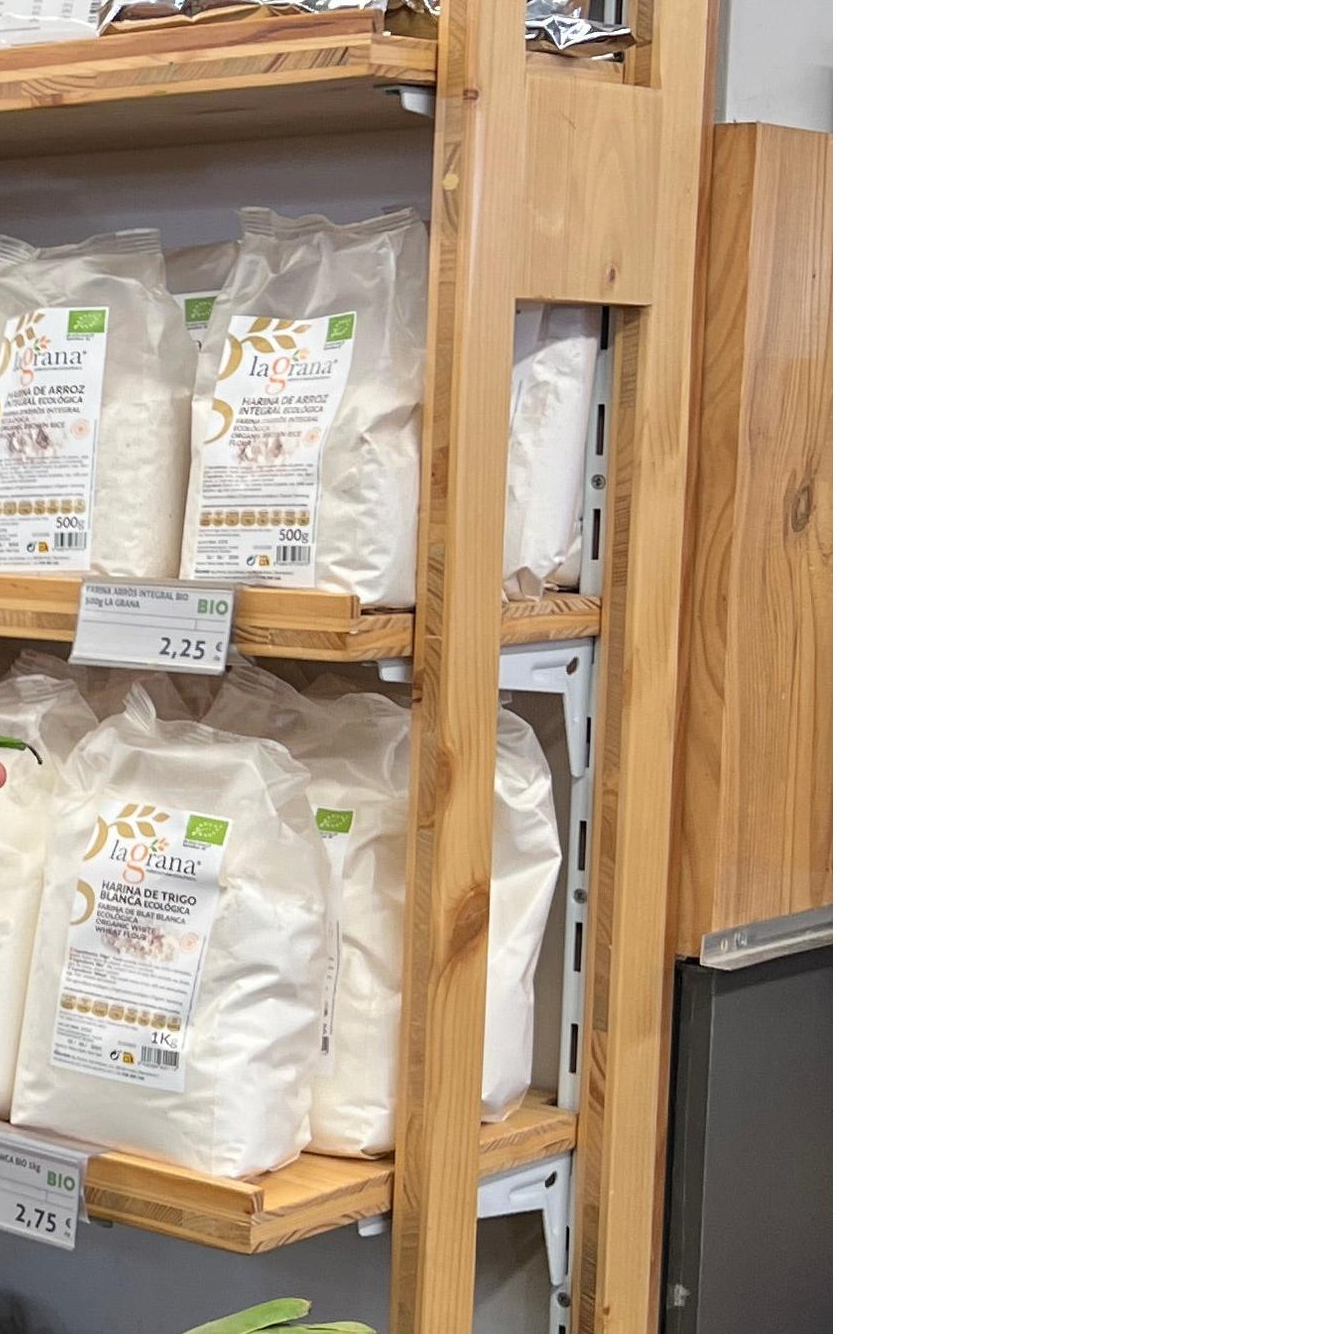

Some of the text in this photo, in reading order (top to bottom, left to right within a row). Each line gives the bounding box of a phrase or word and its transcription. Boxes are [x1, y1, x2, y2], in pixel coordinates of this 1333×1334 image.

[249, 356, 332, 395] lagrana
[33, 385, 85, 395] DE ARROZ
[282, 395, 294, 405] DE
[56, 516, 85, 530] 500g
[279, 529, 308, 544] 500g
[105, 598, 113, 606] LA
[115, 598, 140, 608] GRANA
[139, 589, 173, 600] INTEGRAL
[176, 592, 188, 601] BIO
[197, 598, 229, 615] BIO
[159, 637, 206, 660] 2,25
[110, 839, 196, 884] lagrana
[101, 880, 197, 906] HARINA DE TRIGO
[100, 890, 190, 915] BLANCA ECOLÓGICA
[136, 910, 155, 918] BLAT
[151, 1032, 178, 1049] 1Kg
[15, 1158, 27, 1167] BIO
[47, 1170, 75, 1191] BIO
[15, 1203, 57, 1233] 2,75
